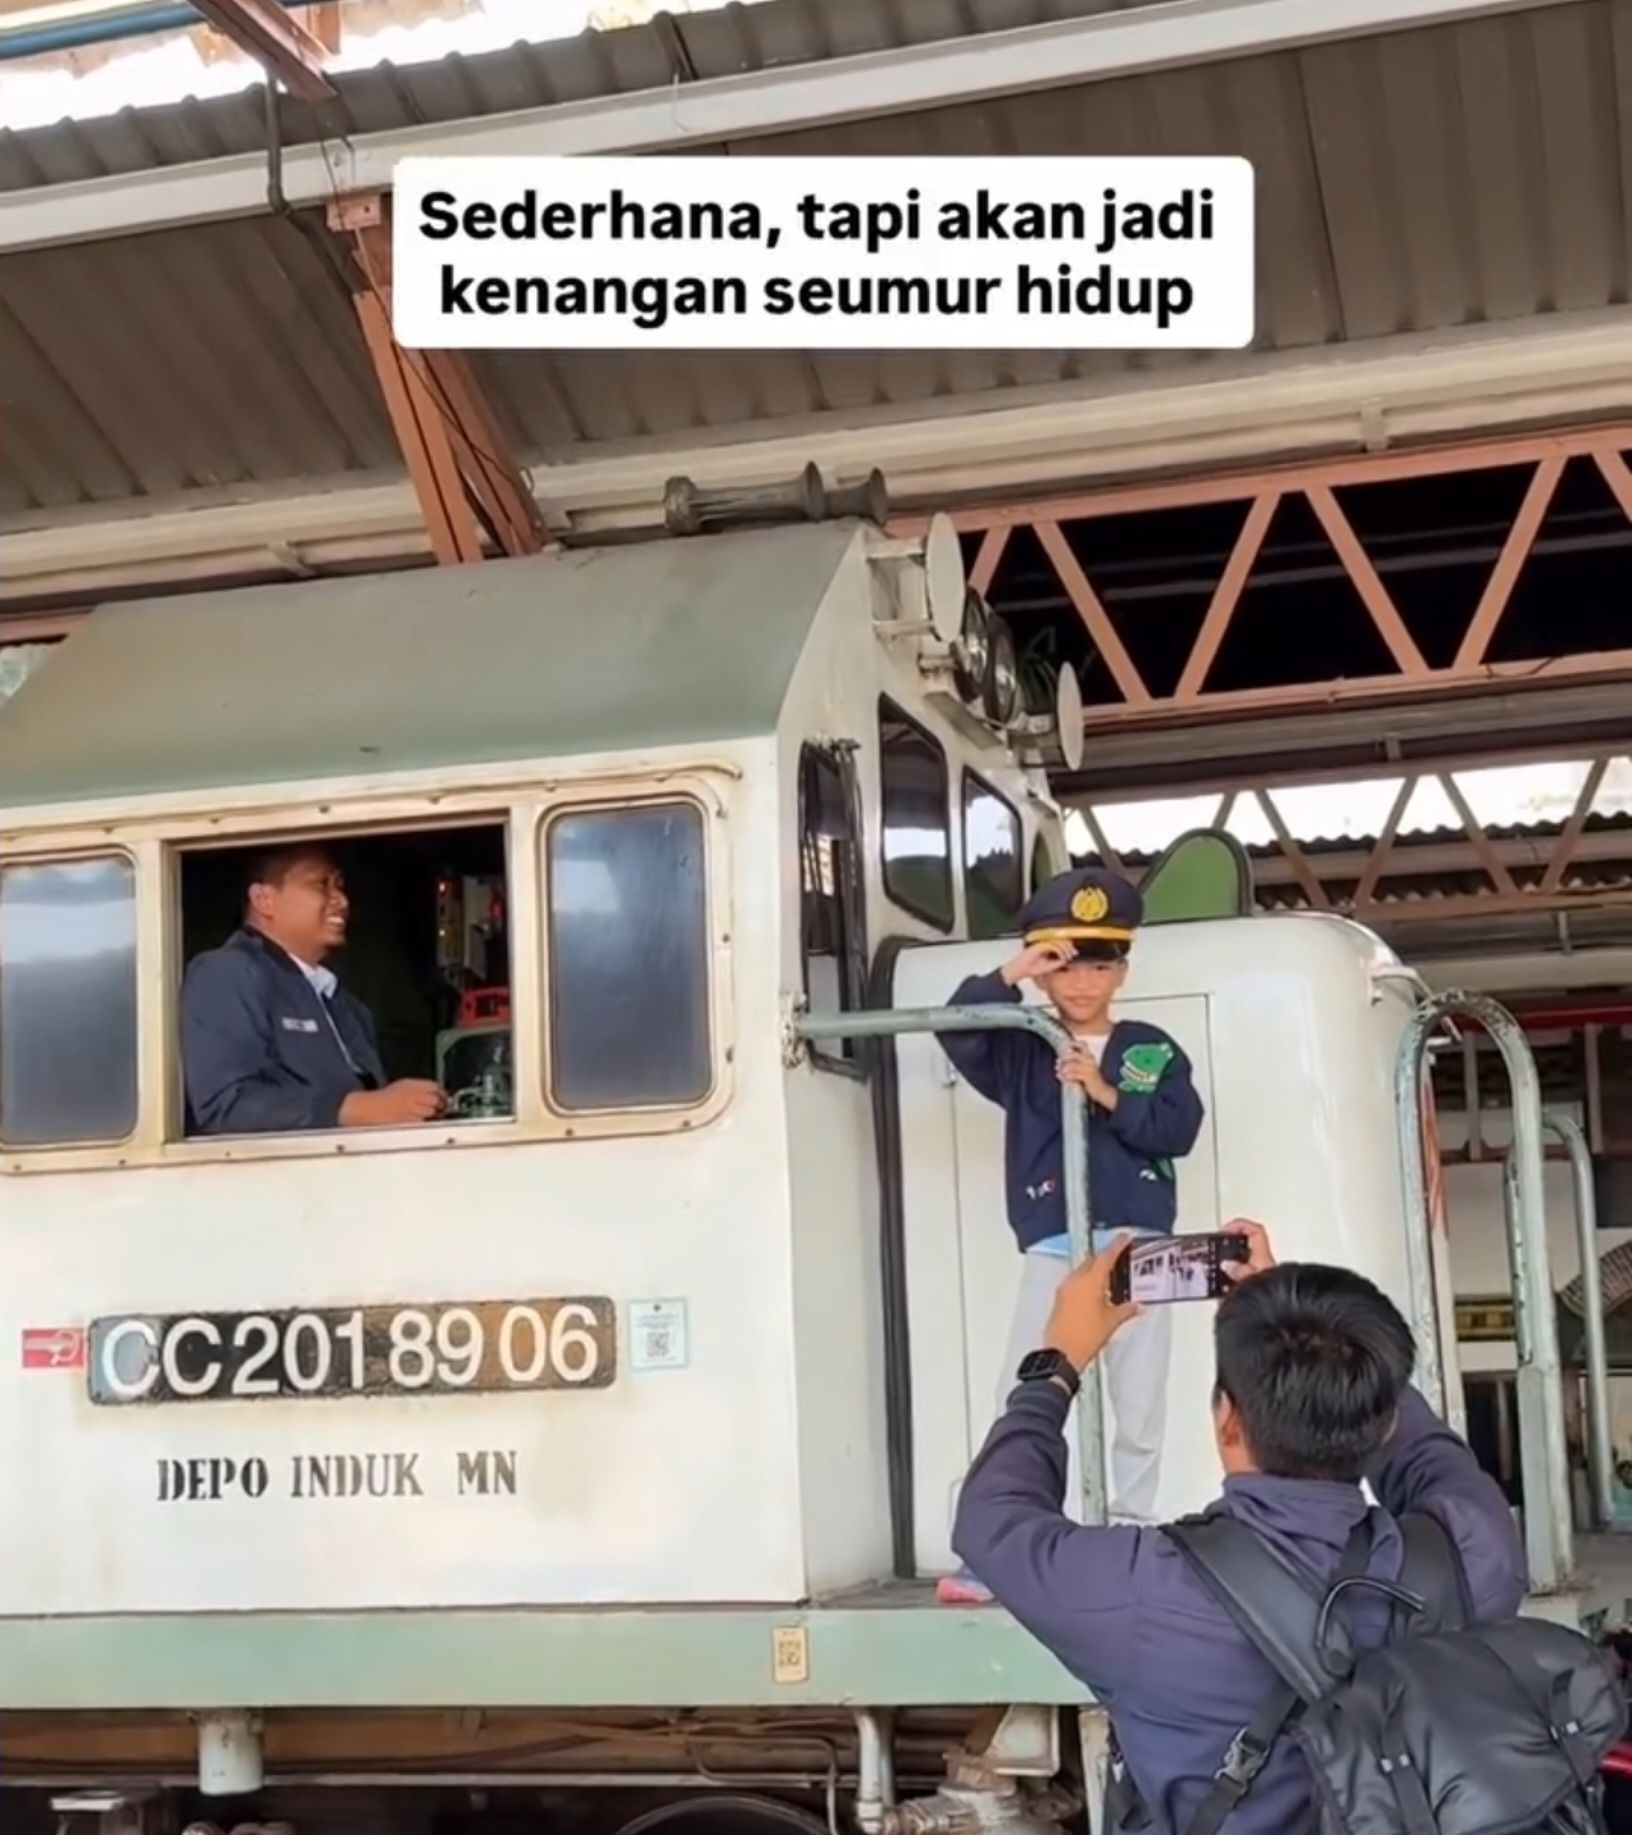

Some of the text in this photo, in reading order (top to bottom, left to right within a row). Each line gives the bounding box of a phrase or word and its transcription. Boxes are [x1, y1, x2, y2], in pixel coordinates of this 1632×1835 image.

[156, 1450, 518, 1501] DEPO INDUK MN
